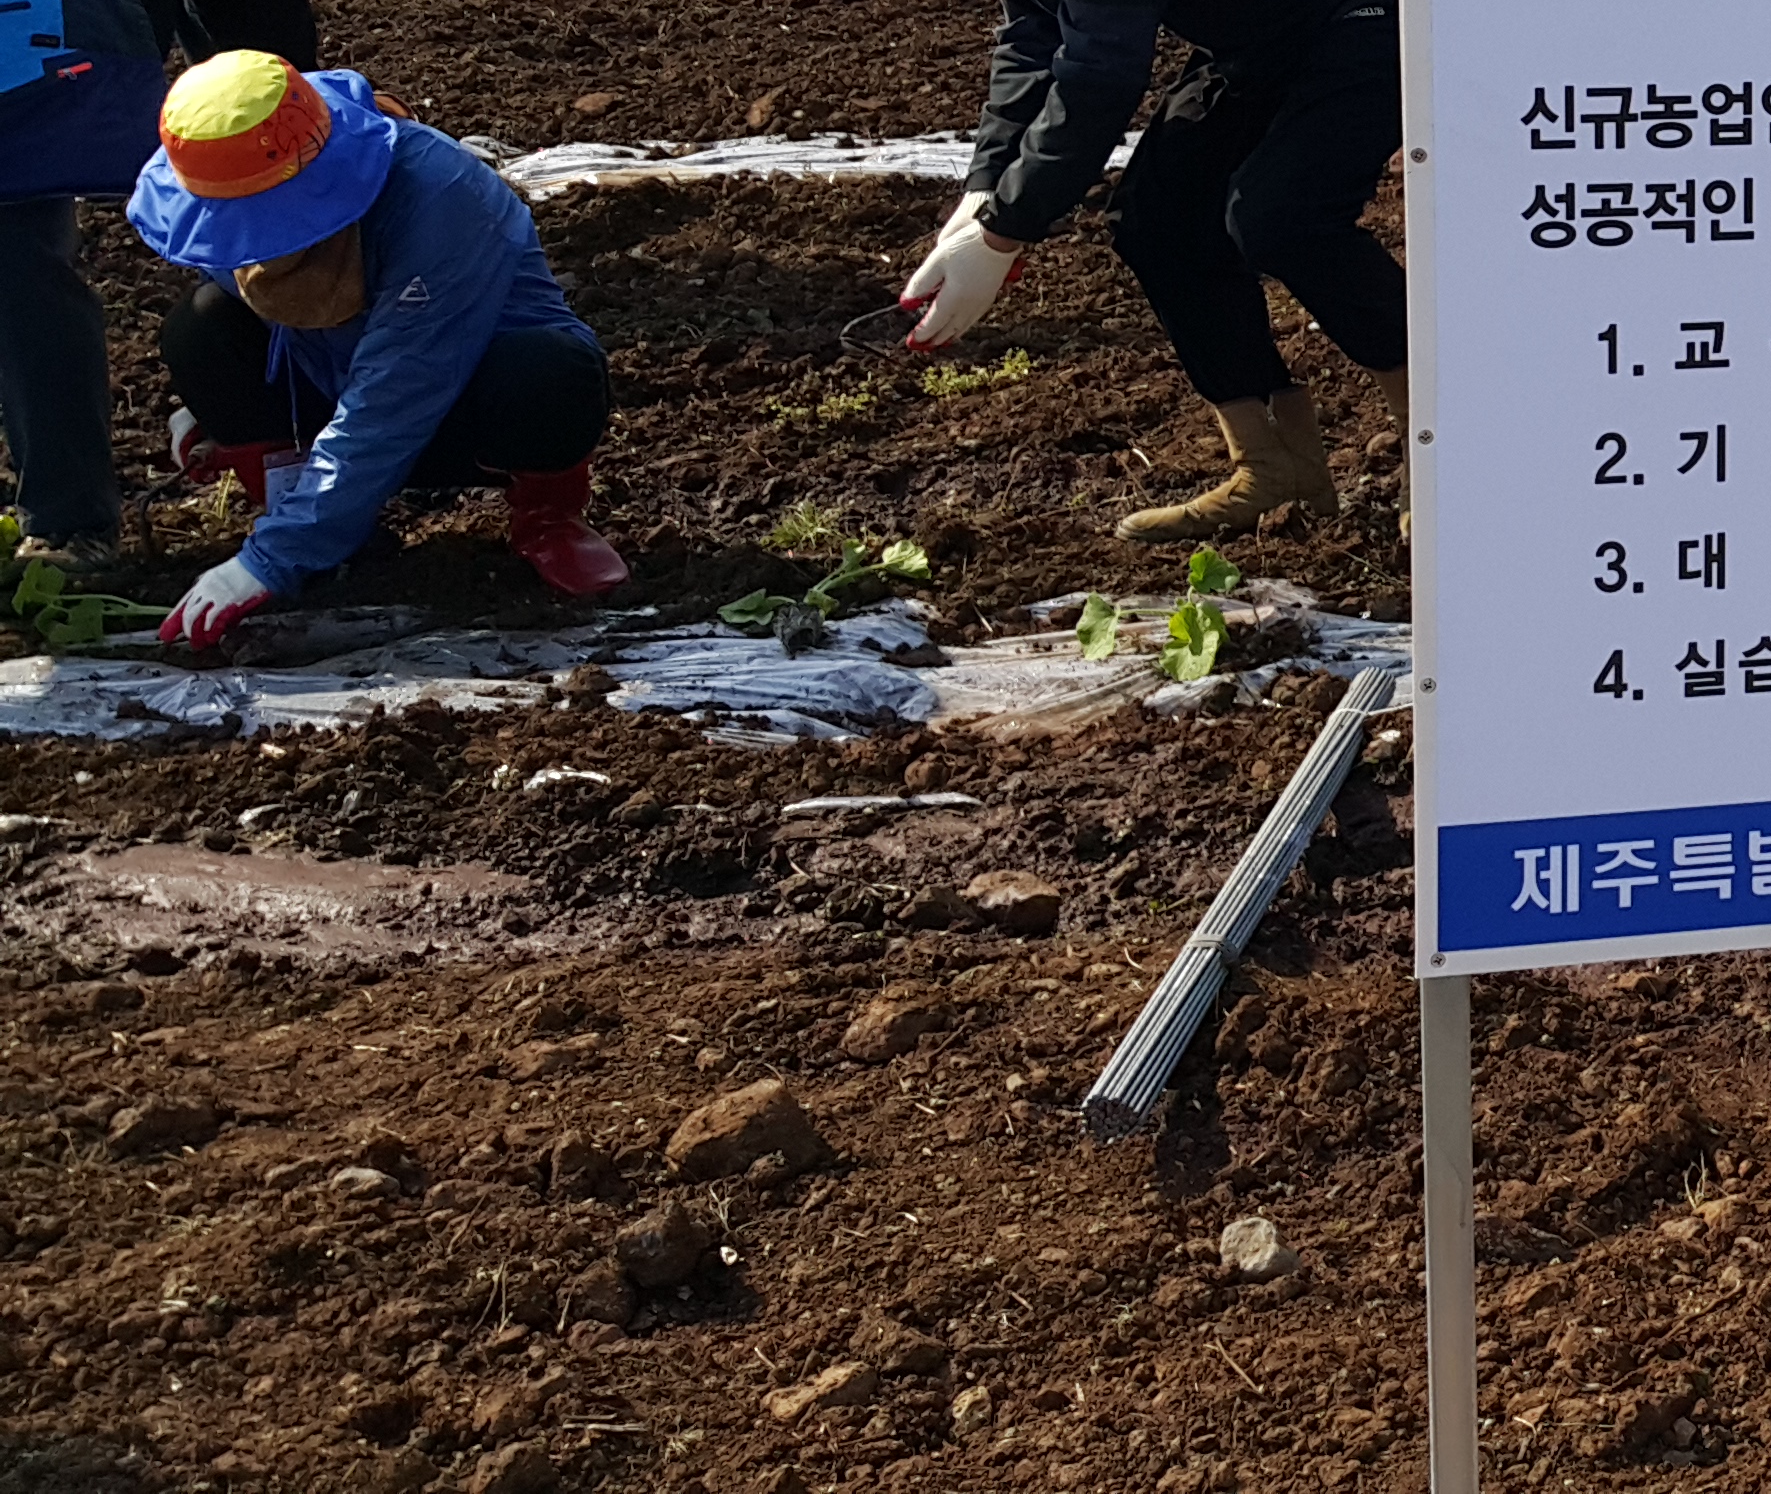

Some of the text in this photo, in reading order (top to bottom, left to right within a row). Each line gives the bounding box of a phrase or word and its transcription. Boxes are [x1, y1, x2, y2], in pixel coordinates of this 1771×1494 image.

[1520, 177, 1755, 249] 성공적인
[1597, 323, 1645, 377] 1.
[1594, 432, 1645, 486] 2.
[1593, 540, 1645, 594] 3.
[1593, 649, 1644, 701] 4.
